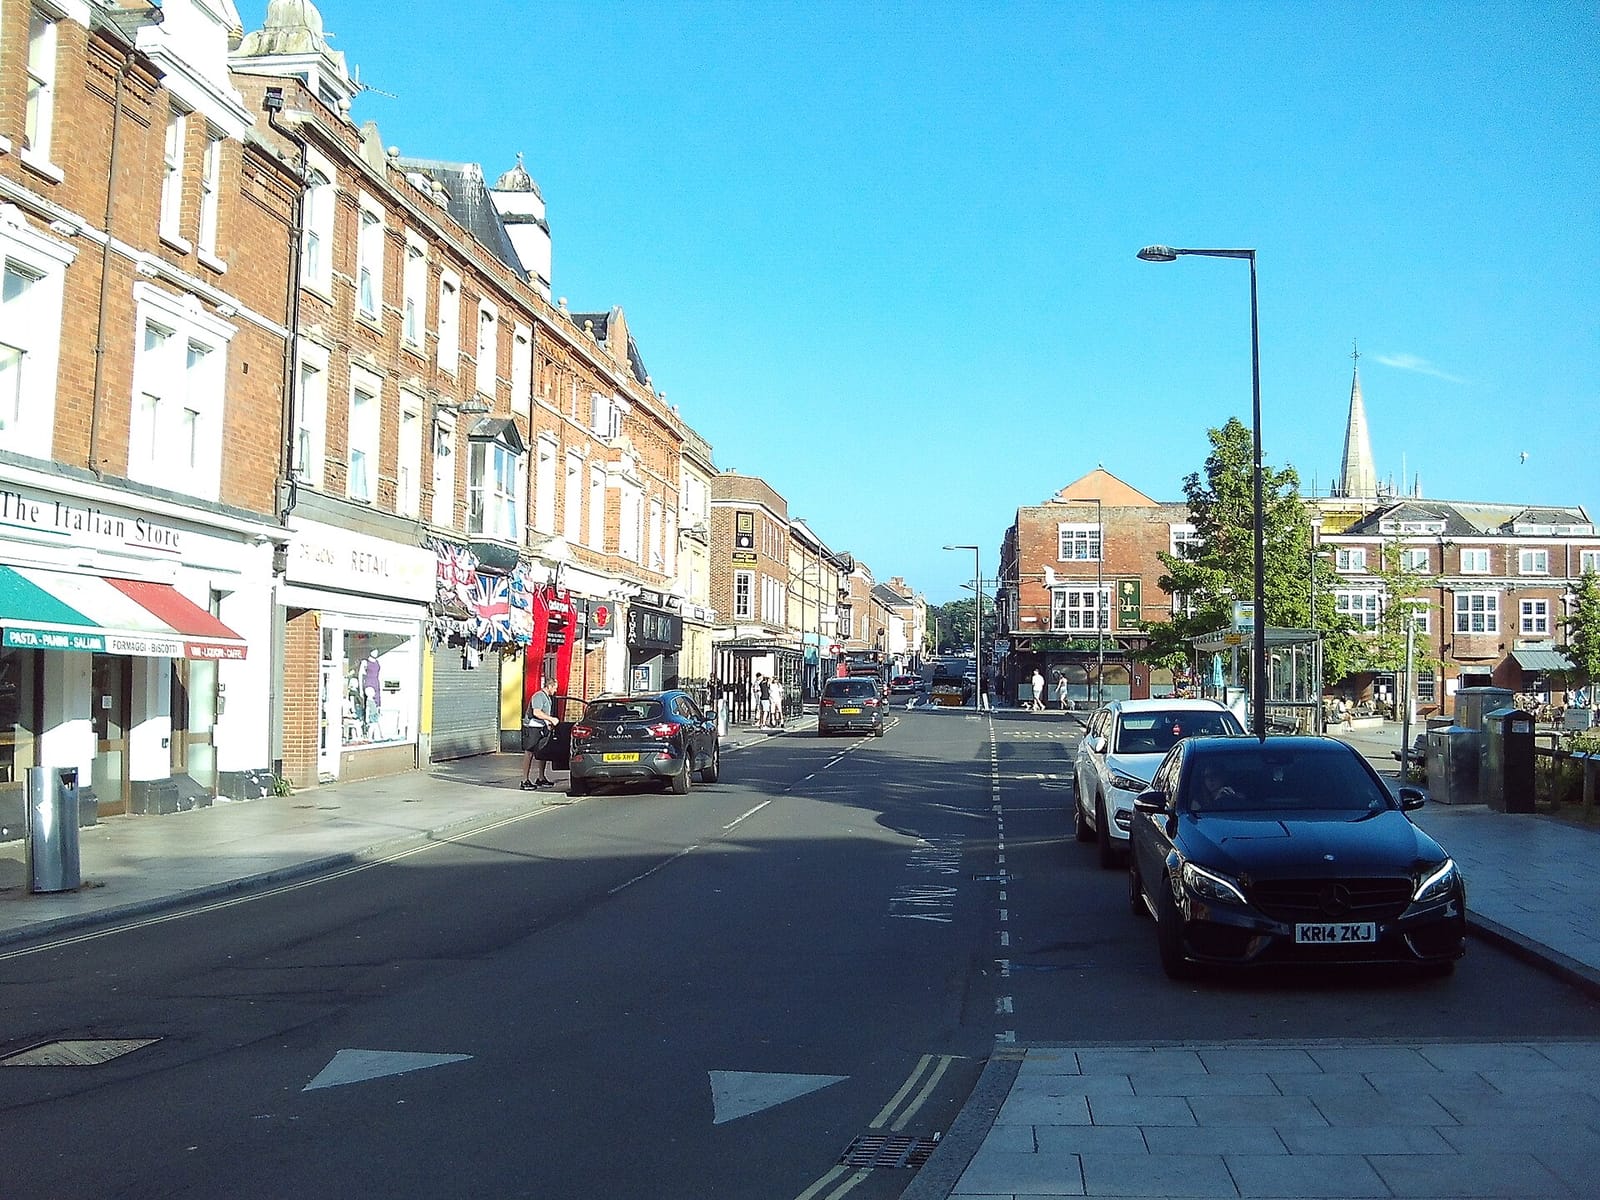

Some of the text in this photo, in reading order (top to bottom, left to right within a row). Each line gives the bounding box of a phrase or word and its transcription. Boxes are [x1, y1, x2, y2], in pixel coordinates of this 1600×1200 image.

[0, 490, 180, 547] The Italian Store
[351, 550, 389, 577] RETAIL
[9, 631, 39, 646] PASTA
[627, 611, 638, 644] CINEMA
[112, 640, 178, 654] FORMAGGI BISCOTTI
[1300, 925, 1371, 942] KR14 ZKJ
